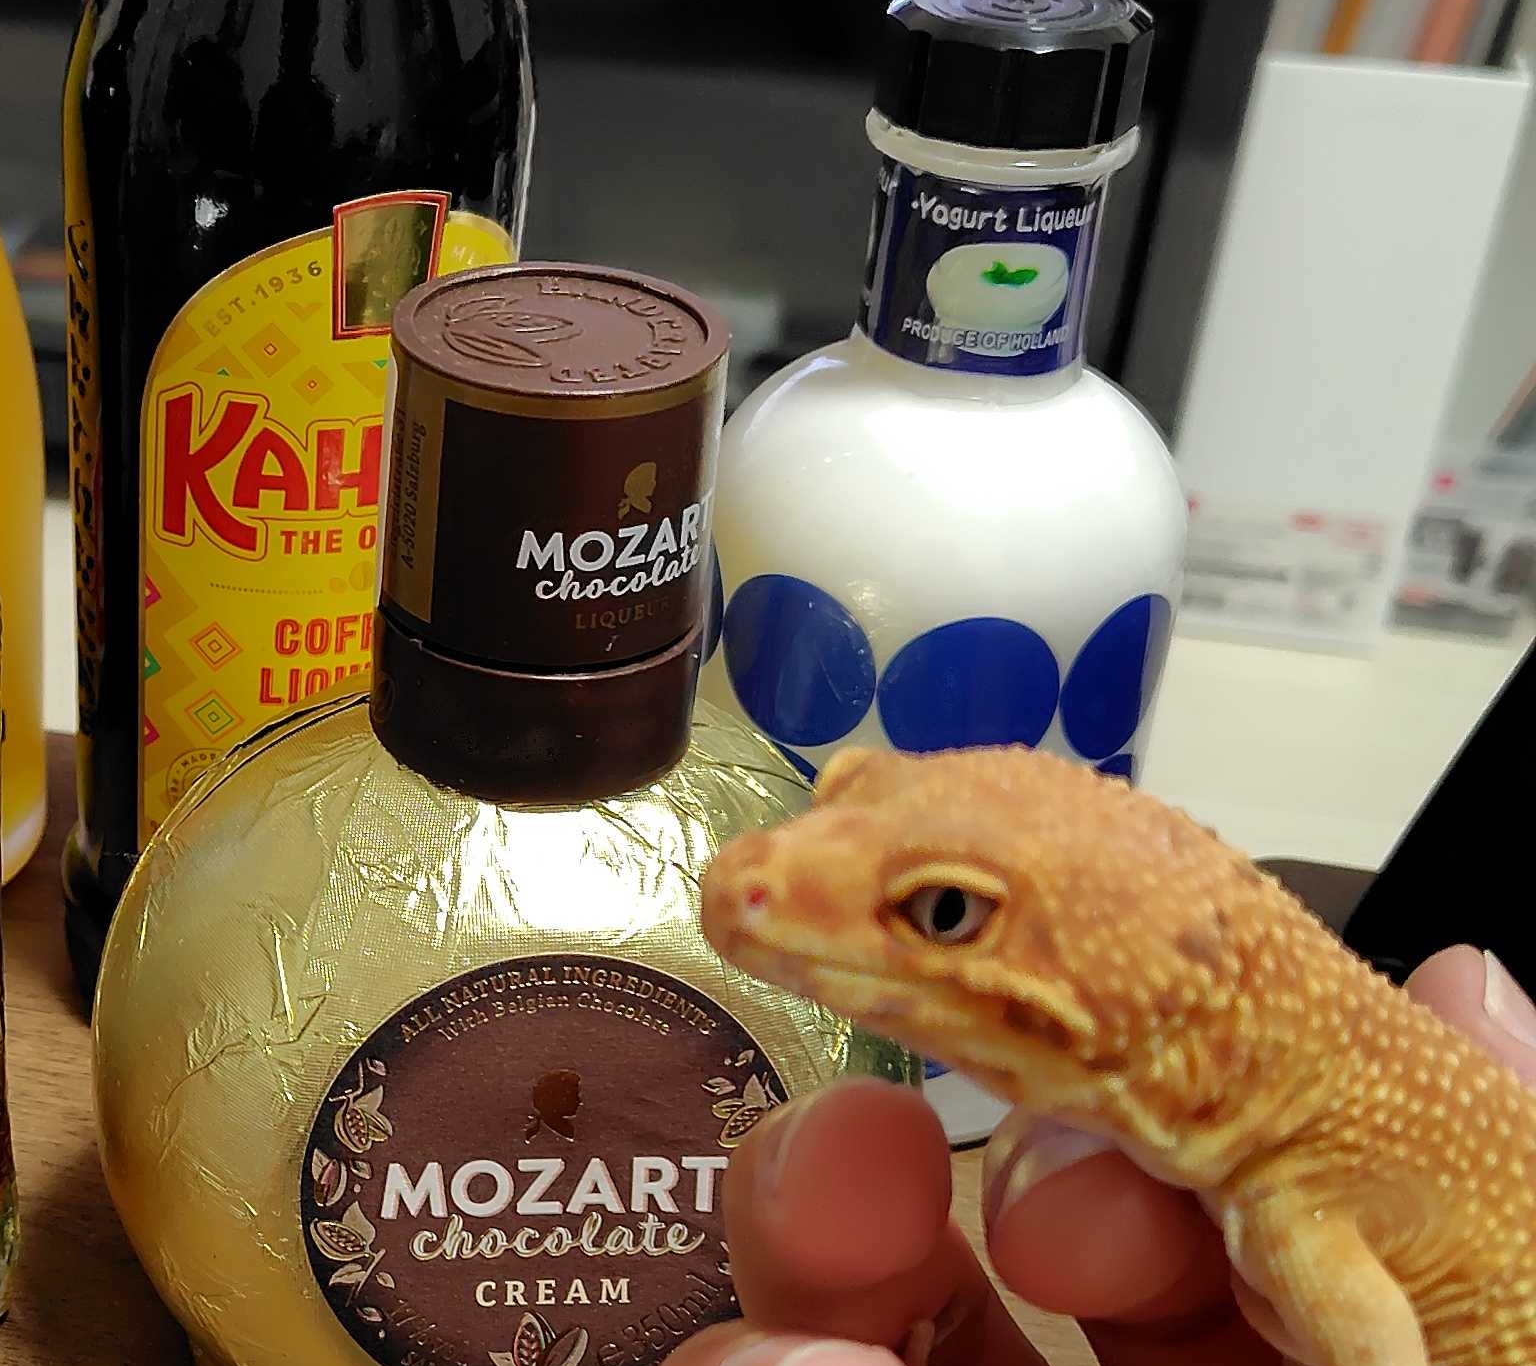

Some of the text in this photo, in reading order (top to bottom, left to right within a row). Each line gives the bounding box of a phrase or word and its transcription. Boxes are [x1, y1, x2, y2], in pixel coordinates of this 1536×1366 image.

[901, 317, 978, 348] PRODUCE
[982, 331, 1007, 348] OF
[163, 392, 381, 551] KAH
[280, 530, 343, 555] THE
[516, 498, 712, 573] MOZART
[535, 544, 702, 603] chocolate
[401, 966, 719, 1043] ALL NATURAL INGREDIENTS
[380, 1155, 730, 1220] MOZART
[410, 1212, 706, 1260] chocolate
[475, 1278, 631, 1308] CREAM
